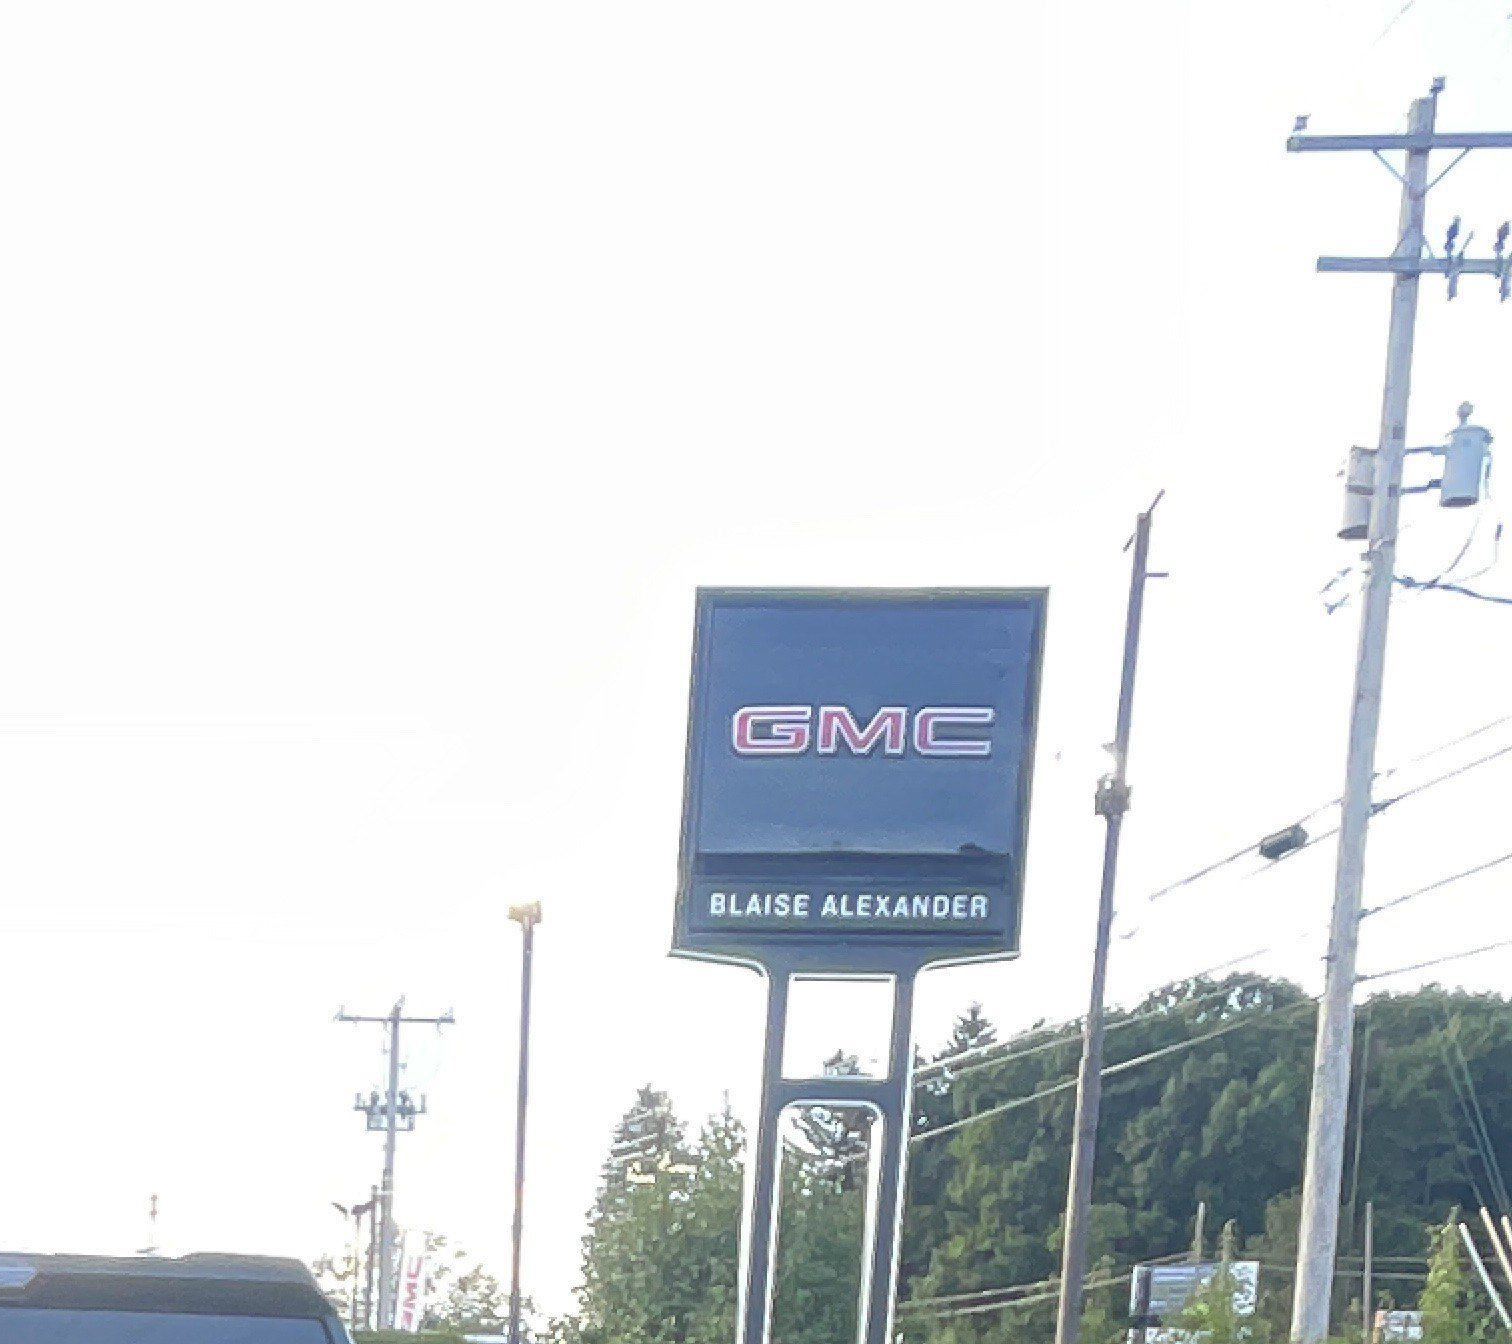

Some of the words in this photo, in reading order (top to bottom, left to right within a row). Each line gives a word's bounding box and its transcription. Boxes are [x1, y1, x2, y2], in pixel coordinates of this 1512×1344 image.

[732, 706, 994, 756] GMC
[709, 892, 810, 917] BLAISE
[820, 894, 989, 919] ALEXANDER
